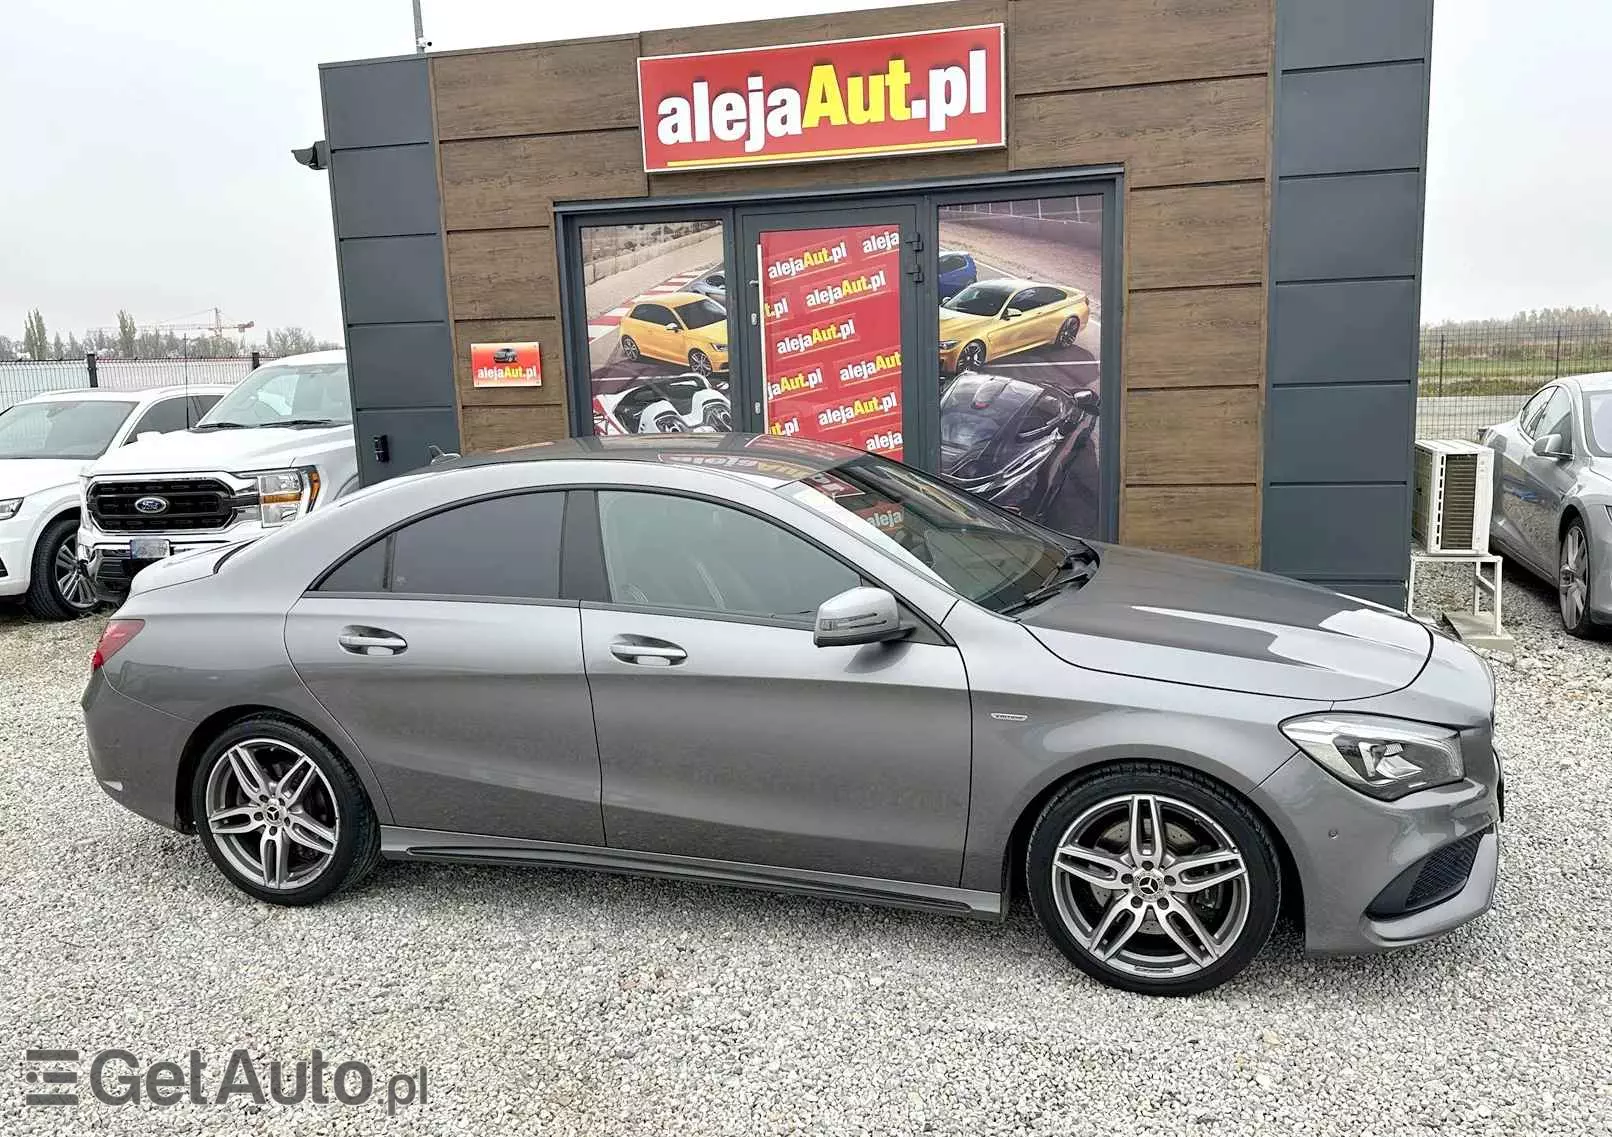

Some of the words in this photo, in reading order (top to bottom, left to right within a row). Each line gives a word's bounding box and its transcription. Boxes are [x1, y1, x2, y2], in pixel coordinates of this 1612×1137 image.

[657, 49, 987, 153] alejaAut.pl
[768, 242, 847, 277] alejaAut.pl
[806, 271, 886, 306] alejaAut.pl
[776, 320, 855, 354] alejaAut.pl
[477, 365, 537, 380] alejaAut.pl
[817, 392, 897, 425] alejaAut.pl
